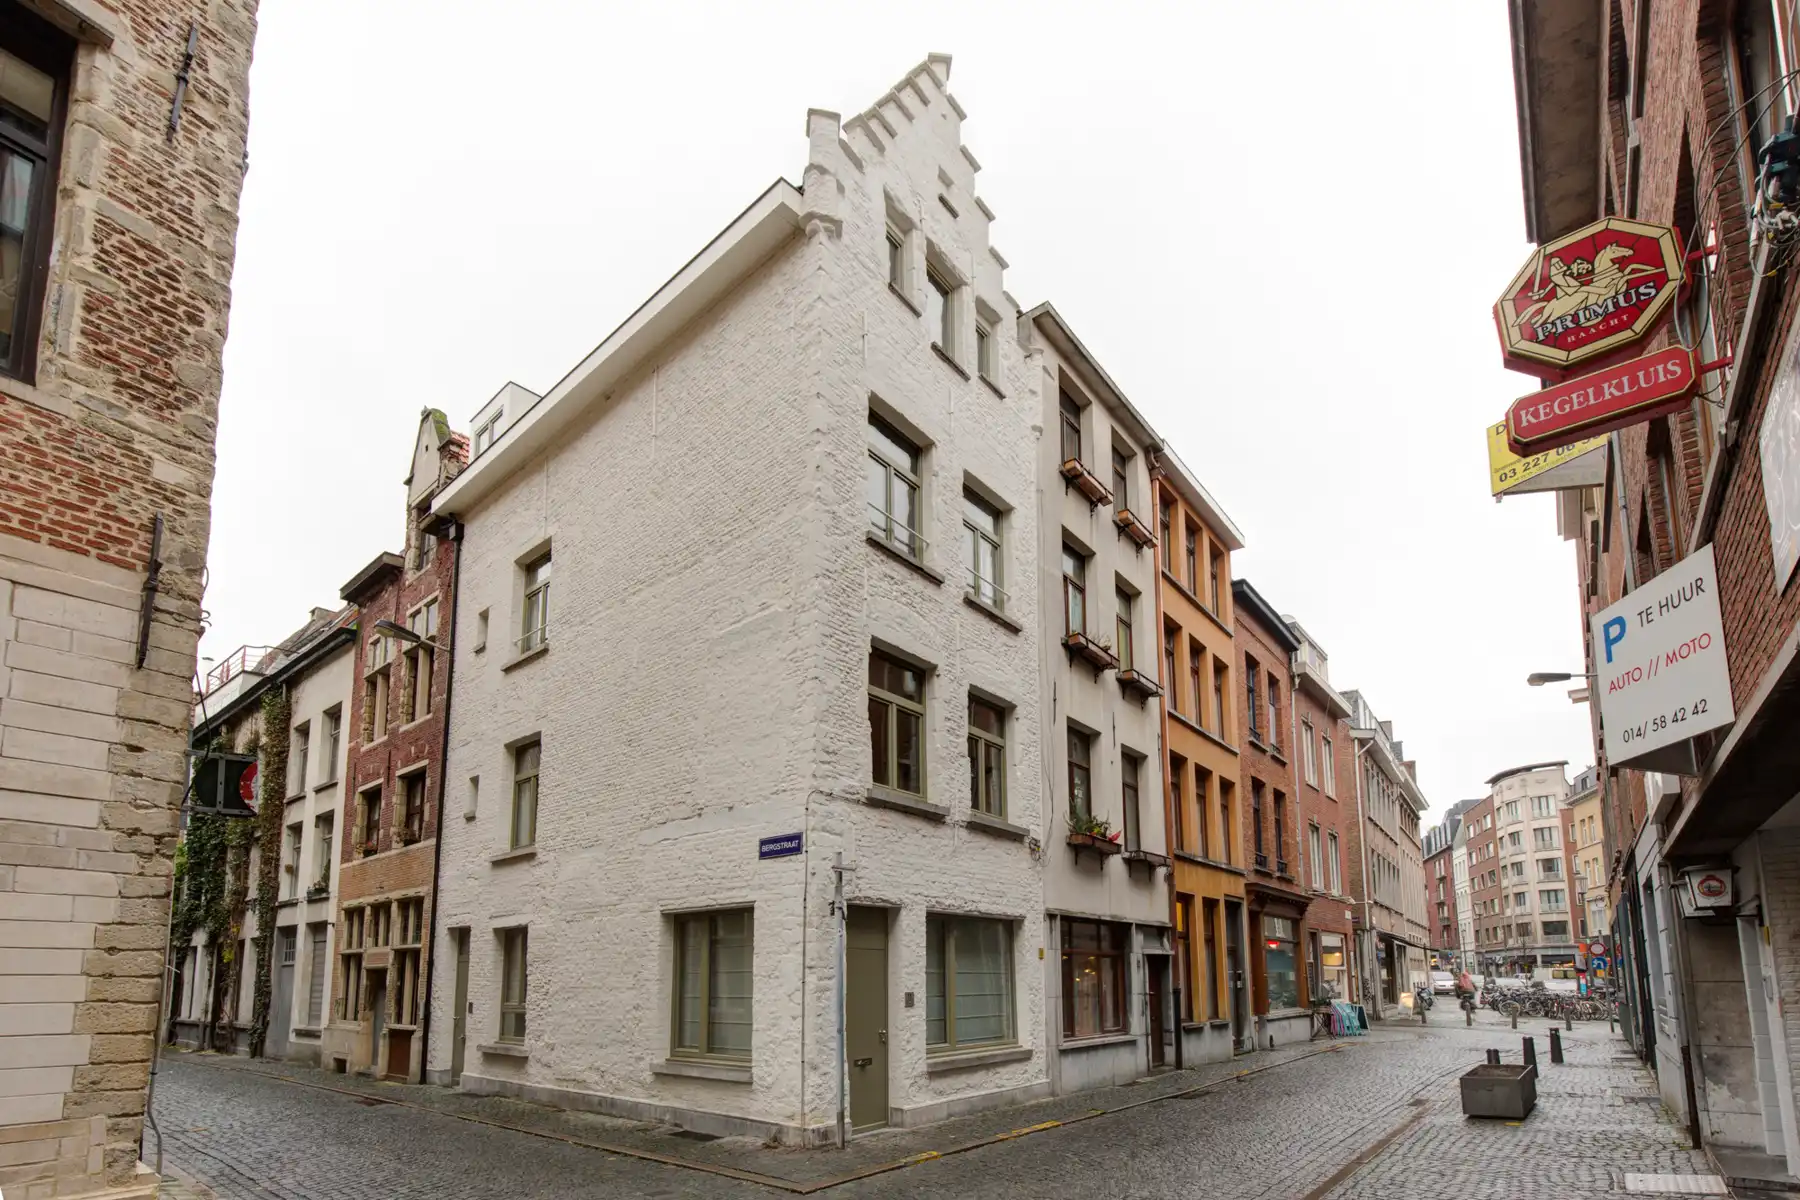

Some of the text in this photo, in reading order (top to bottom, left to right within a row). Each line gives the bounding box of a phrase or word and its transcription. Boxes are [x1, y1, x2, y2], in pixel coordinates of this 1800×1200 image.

[1534, 280, 1657, 342] PRIMUS
[1567, 314, 1629, 343] HAACHT
[1519, 359, 1682, 427] KEGELKLUIS
[1499, 467, 1517, 483] 03
[1522, 451, 1550, 473] 227
[1603, 577, 1705, 664] P TE HUUR
[1608, 665, 1643, 694] AUTO
[1665, 632, 1711, 667] MOTO
[1622, 699, 1708, 743] 014/ 58 42 42
[761, 840, 799, 852] BERGSTRAAT
